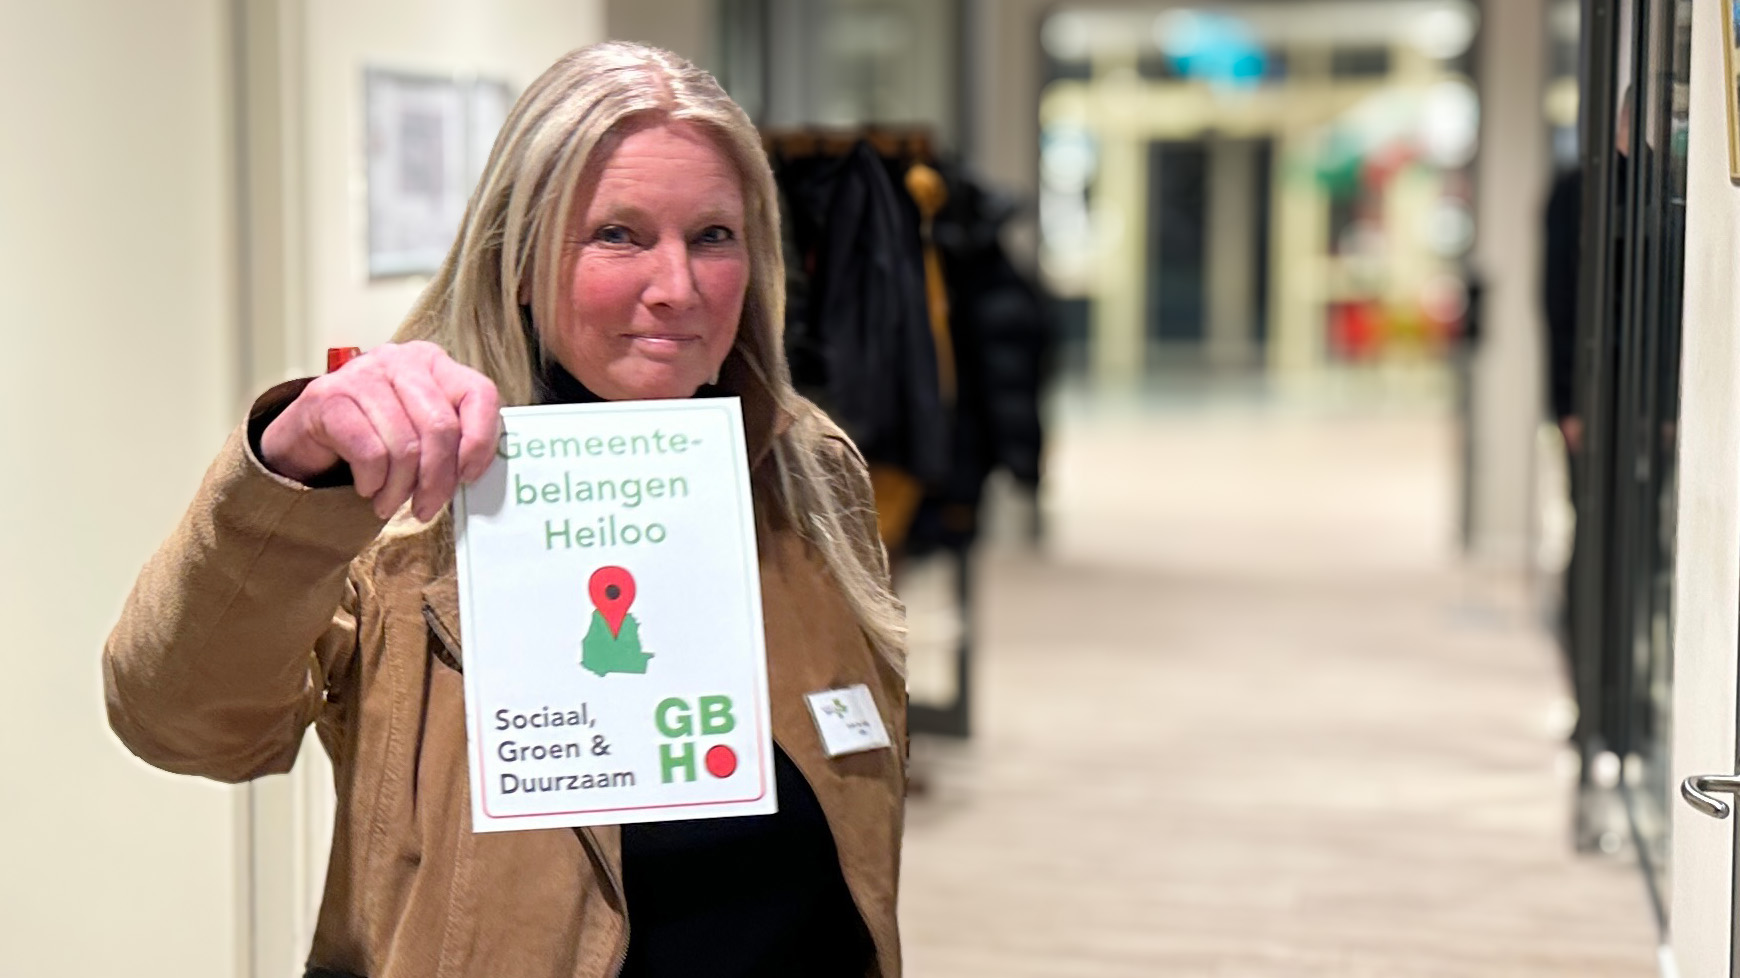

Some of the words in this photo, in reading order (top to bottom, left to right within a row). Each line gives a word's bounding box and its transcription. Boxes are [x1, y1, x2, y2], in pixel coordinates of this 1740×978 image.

[497, 429, 704, 460] Gemeente-
[514, 471, 689, 509] belangen
[545, 515, 667, 550] Heiloo
[495, 703, 597, 731] Sociaal,
[655, 695, 736, 738] GB
[498, 741, 581, 763] Groen
[591, 735, 612, 757] &
[501, 770, 636, 795] Duurzaam
